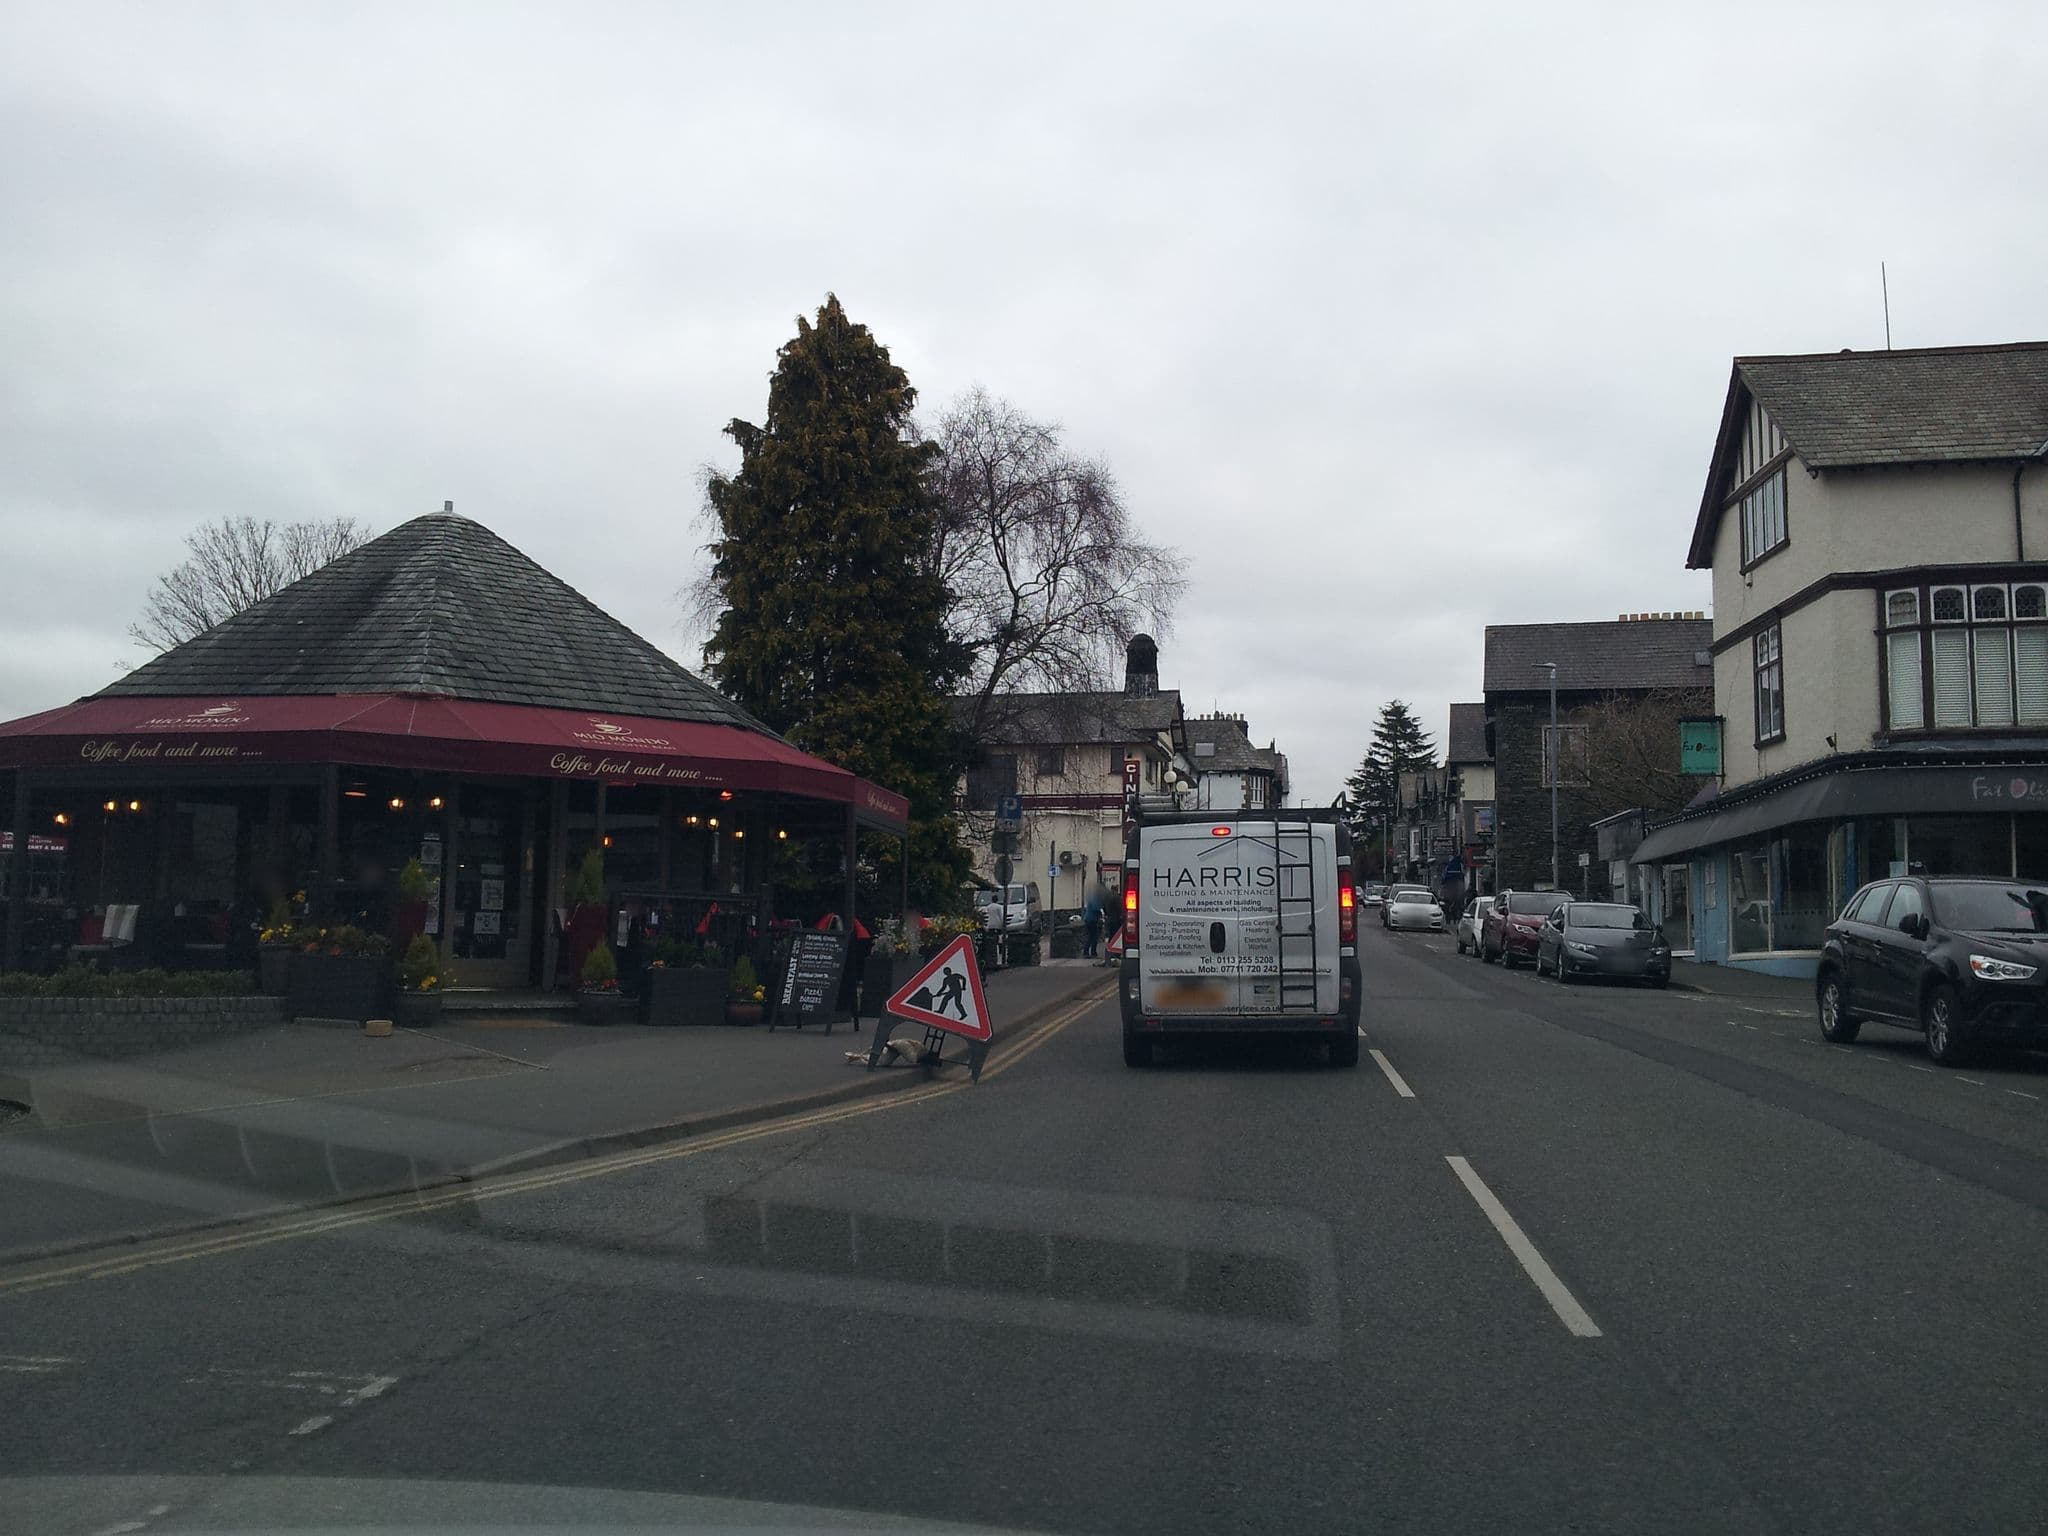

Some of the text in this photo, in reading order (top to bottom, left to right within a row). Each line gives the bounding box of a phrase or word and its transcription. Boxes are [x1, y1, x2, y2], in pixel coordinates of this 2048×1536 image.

[573, 731, 605, 741] MIO
[608, 734, 670, 746] MONDO
[81, 740, 122, 762] Coffee
[122, 740, 162, 761] food
[164, 741, 199, 757] and
[200, 746, 238, 757] more
[550, 752, 593, 774] Coffee
[589, 757, 631, 776] food
[634, 763, 665, 777] and
[666, 767, 702, 780] more
[1972, 776, 2048, 800] Fat Oli
[1002, 797, 1018, 817] P
[1154, 866, 1275, 888] HARRIS
[1153, 888, 1276, 897] BUILDING & MAINTENANCE
[1233, 898, 1262, 908] building
[1172, 920, 1205, 928] Decorating
[1151, 928, 1167, 936] Tiling
[1172, 928, 1200, 936] Plumbing
[1246, 927, 1269, 935] Heating
[1149, 935, 1173, 943] Building
[1178, 934, 1202, 942] Roofing
[1217, 956, 1236, 964] 0113
[1238, 956, 1253, 964] 255
[1221, 965, 1244, 973] 07711
[1247, 965, 1262, 973] 720
[1263, 965, 1278, 973] 242
[782, 957, 798, 1005] BREAKFAST
